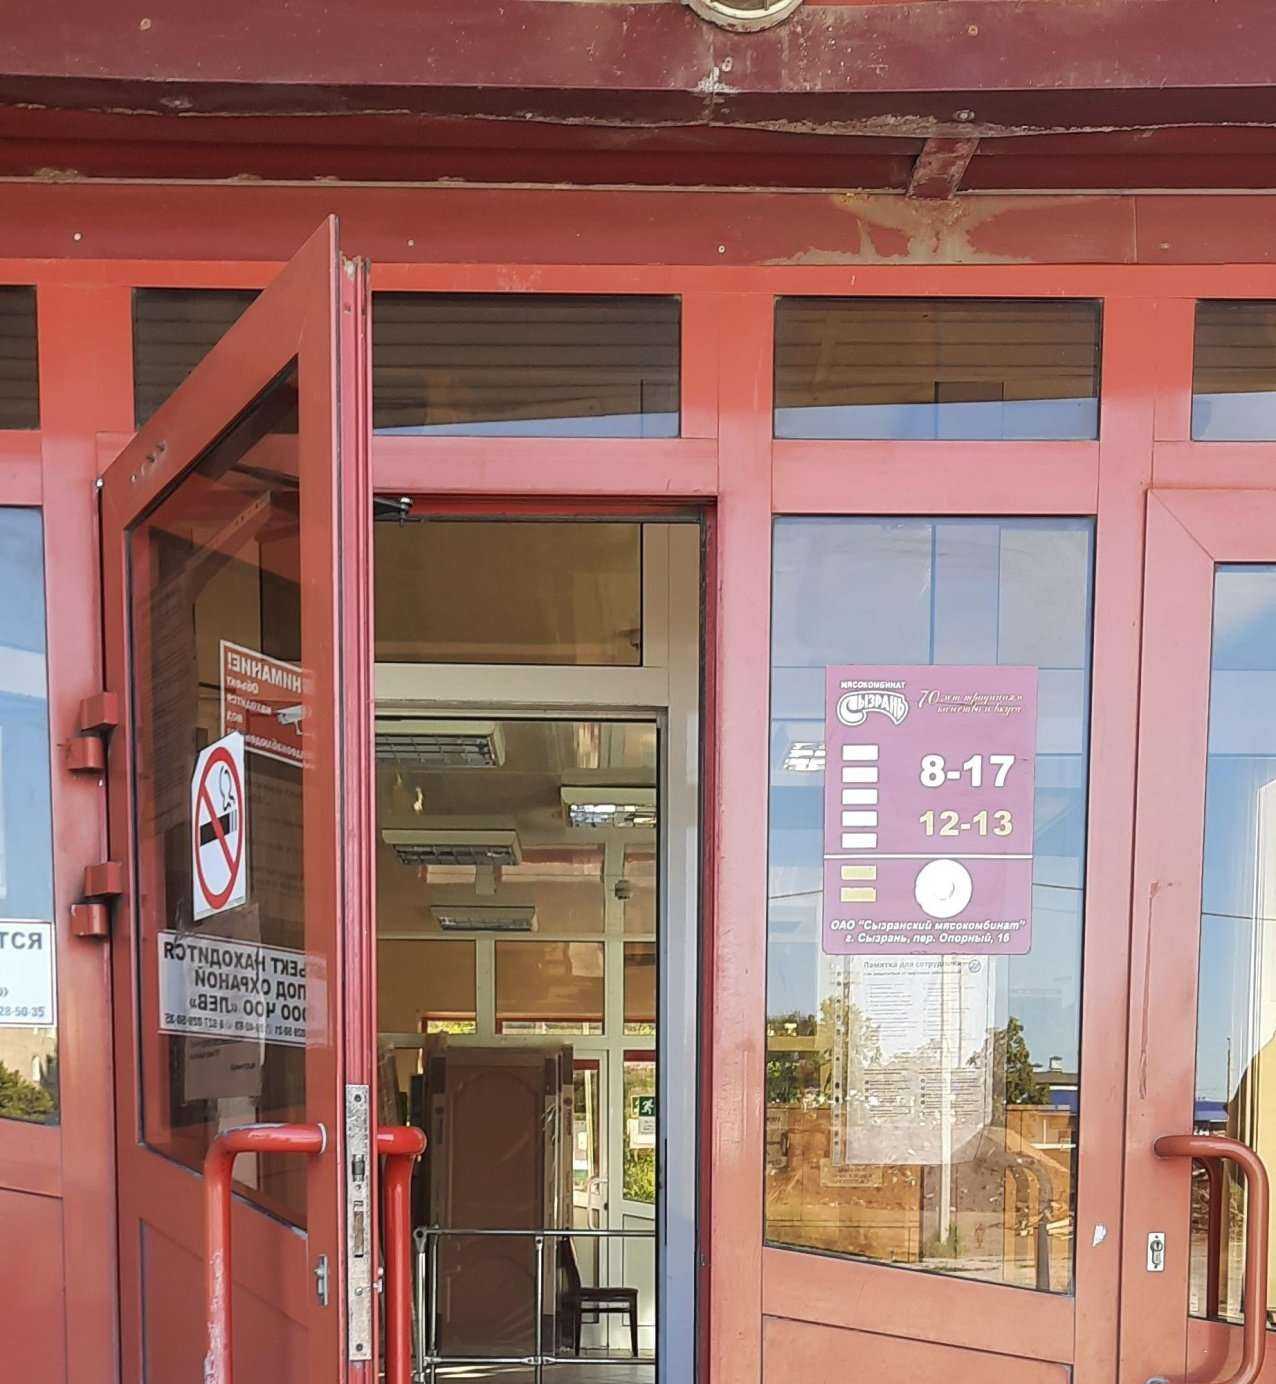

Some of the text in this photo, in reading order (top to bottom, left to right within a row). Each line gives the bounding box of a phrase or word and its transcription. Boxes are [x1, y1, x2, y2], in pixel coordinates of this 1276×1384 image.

[917, 689, 940, 708] 70
[919, 753, 1016, 788] 8-17
[919, 809, 1014, 836] 12-13
[830, 920, 856, 930] ОАО
[0, 931, 43, 950] ТСЯ
[858, 933, 911, 945] Сызрань,
[913, 934, 936, 945] пер.
[938, 932, 995, 945] Опорный,
[997, 933, 1011, 943] 16
